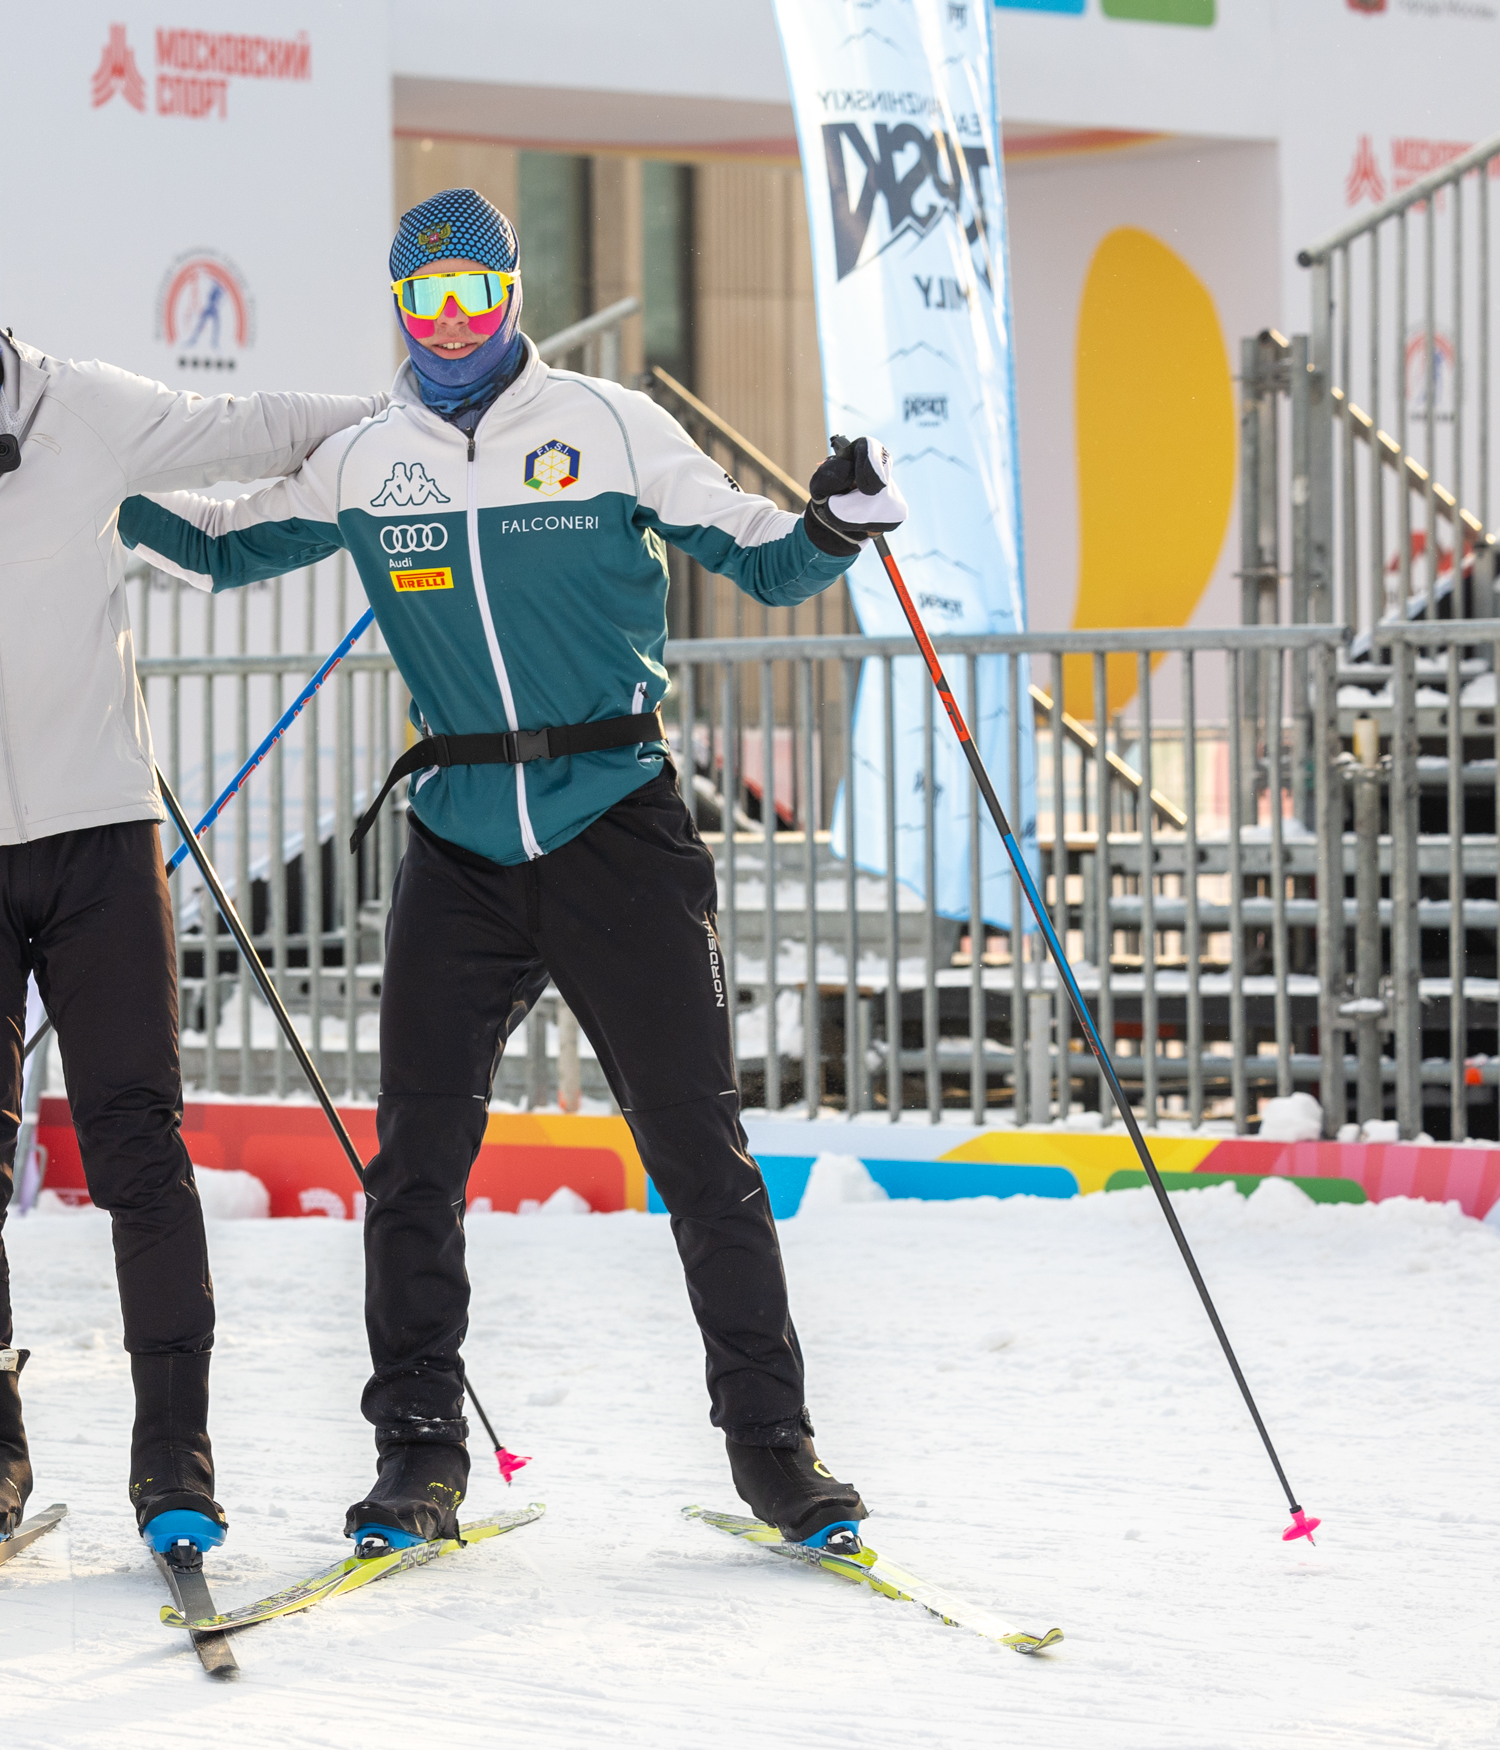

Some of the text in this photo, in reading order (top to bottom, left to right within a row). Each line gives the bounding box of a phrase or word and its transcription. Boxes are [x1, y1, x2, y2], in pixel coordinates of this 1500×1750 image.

[156, 26, 311, 82] МОСКОВСКИЙ
[156, 74, 228, 121] СПОРТ
[502, 516, 599, 534] FALCONERI
[389, 557, 413, 568] Audi
[396, 571, 446, 588] PIRELLI
[899, 585, 937, 664] PROGRESSIVE DESIGN
[400, 1542, 443, 1570] FISCHER
